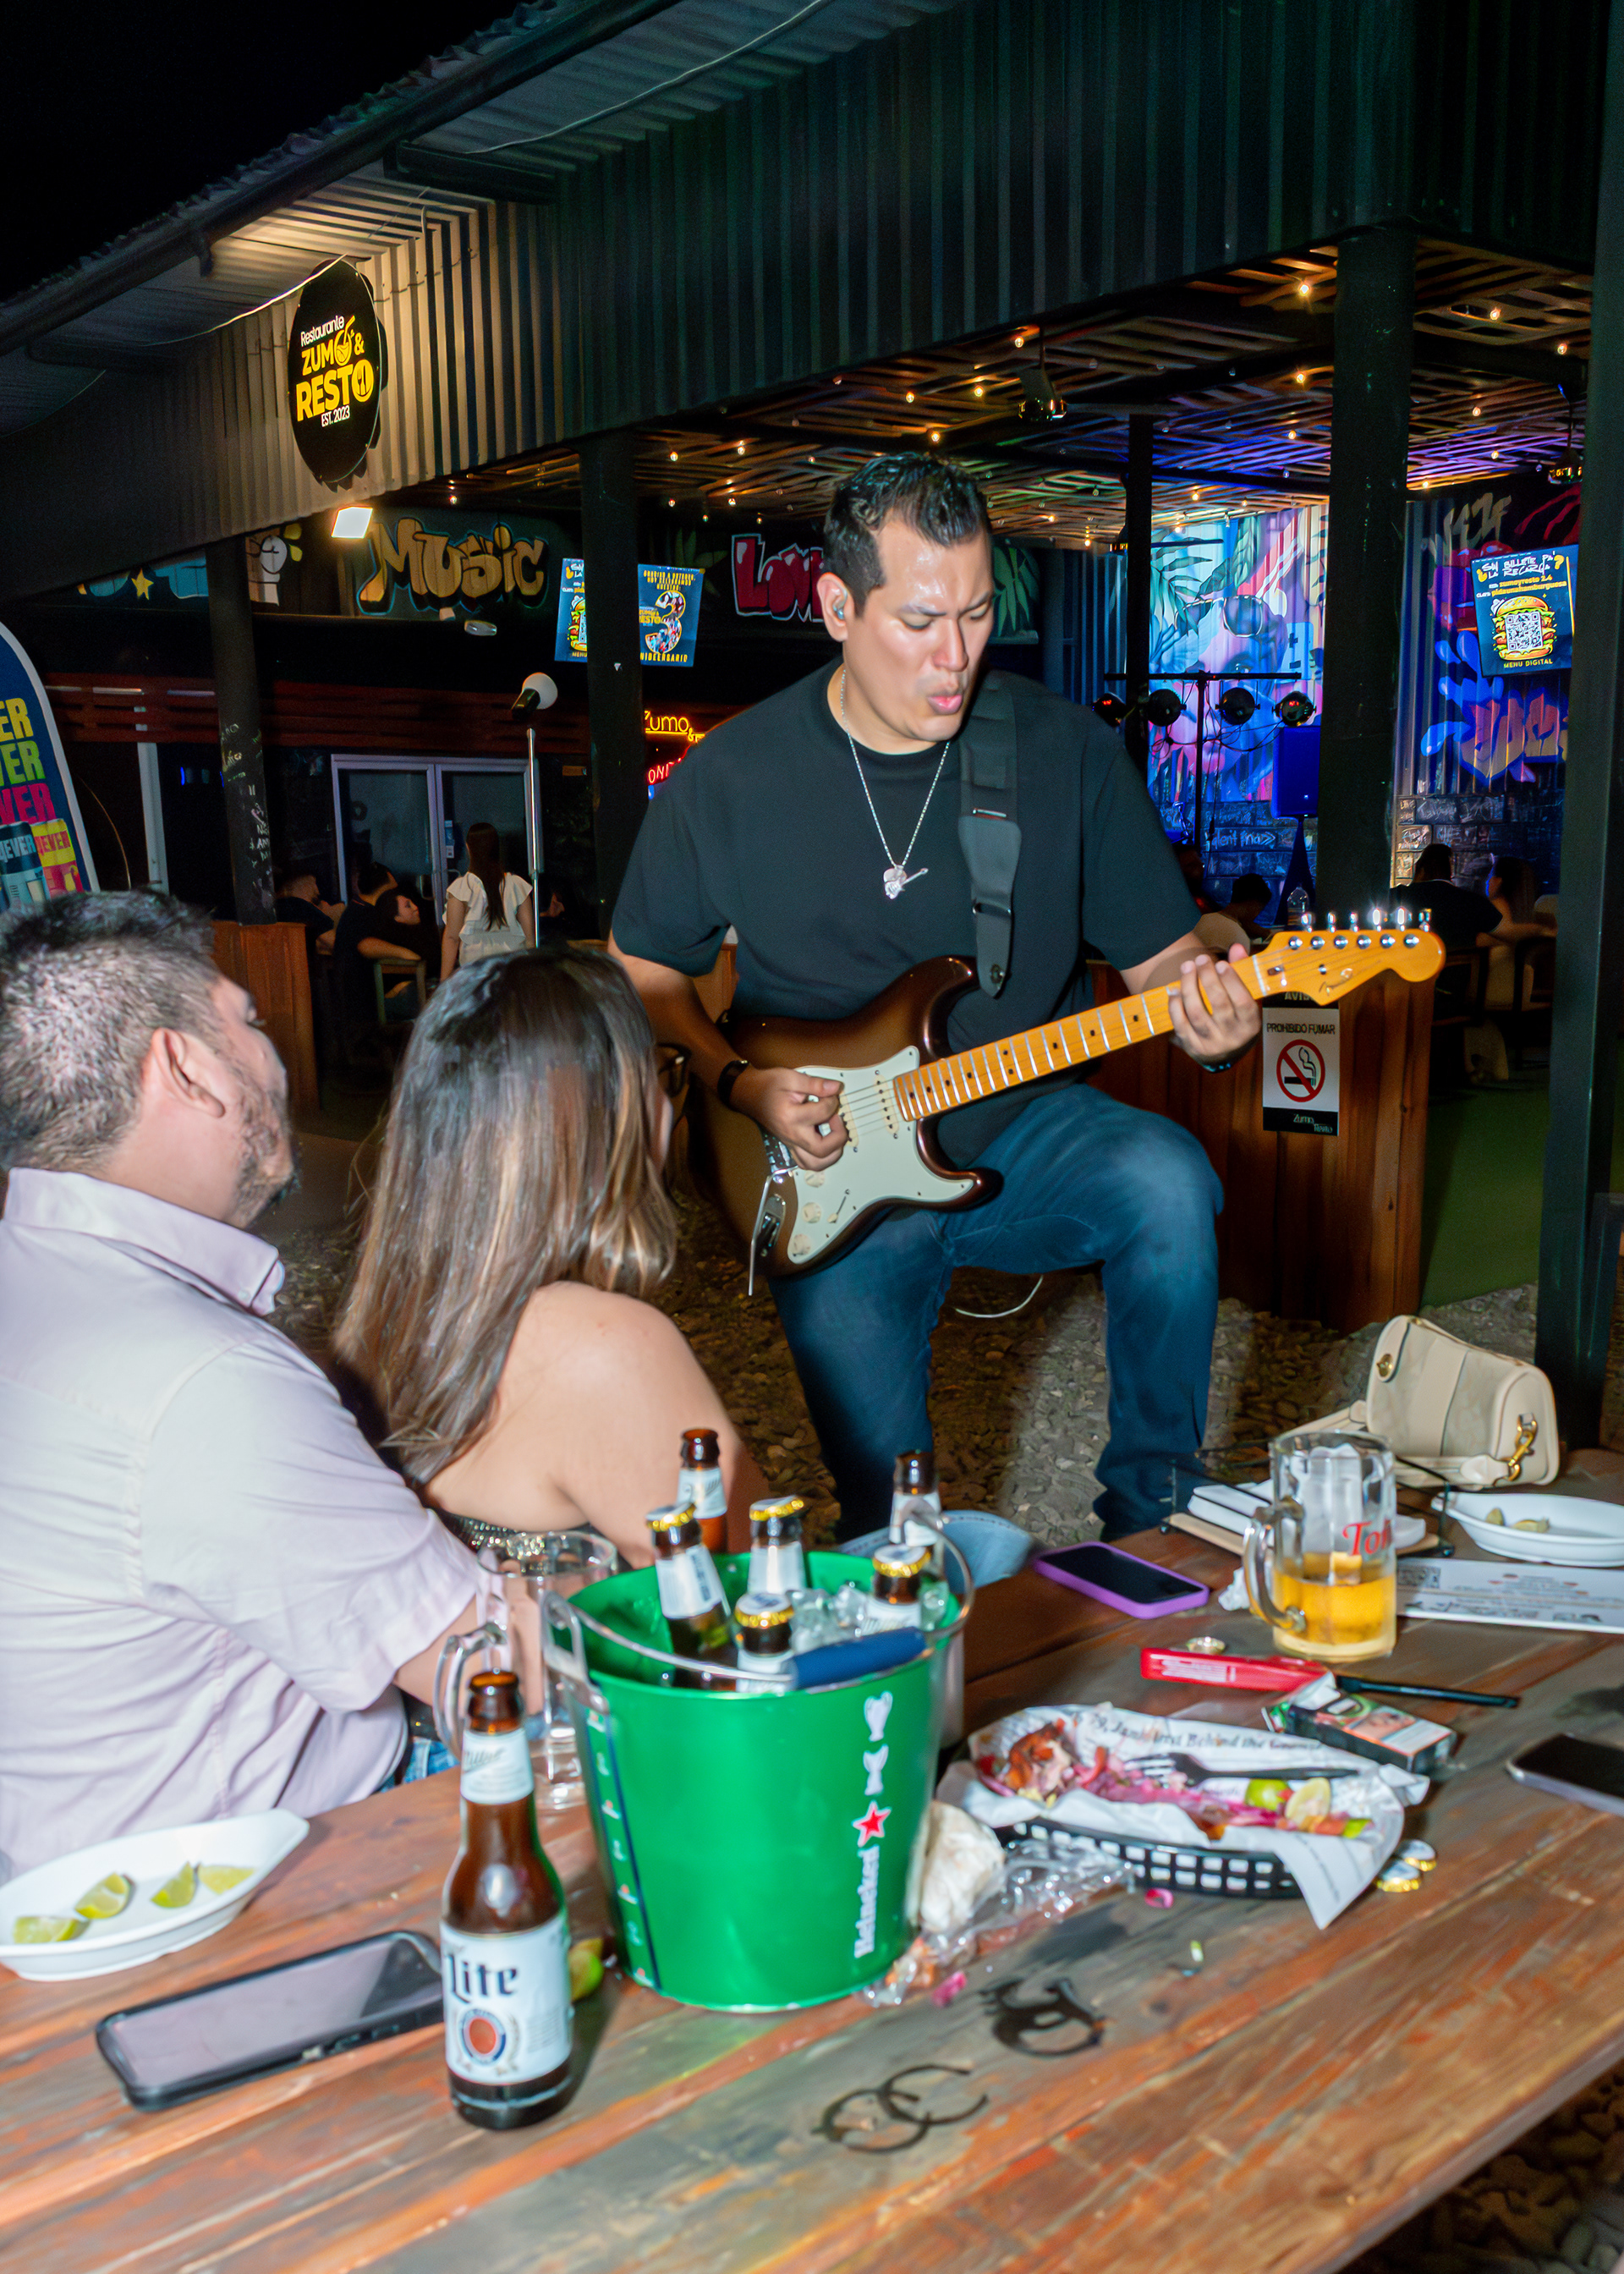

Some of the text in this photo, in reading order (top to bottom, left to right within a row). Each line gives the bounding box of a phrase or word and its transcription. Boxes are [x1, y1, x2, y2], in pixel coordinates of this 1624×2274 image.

[300, 316, 344, 347] Restaurante
[301, 328, 365, 376] ZUMO &
[296, 359, 374, 422] RESTO
[321, 405, 350, 427] EST. 2023
[1503, 557, 1537, 568] BILLETE
[1525, 658, 1553, 667] DIGITAL
[1266, 1023, 1336, 1035] PROHIBIDO FUMAR
[444, 1953, 518, 2003] Lite
